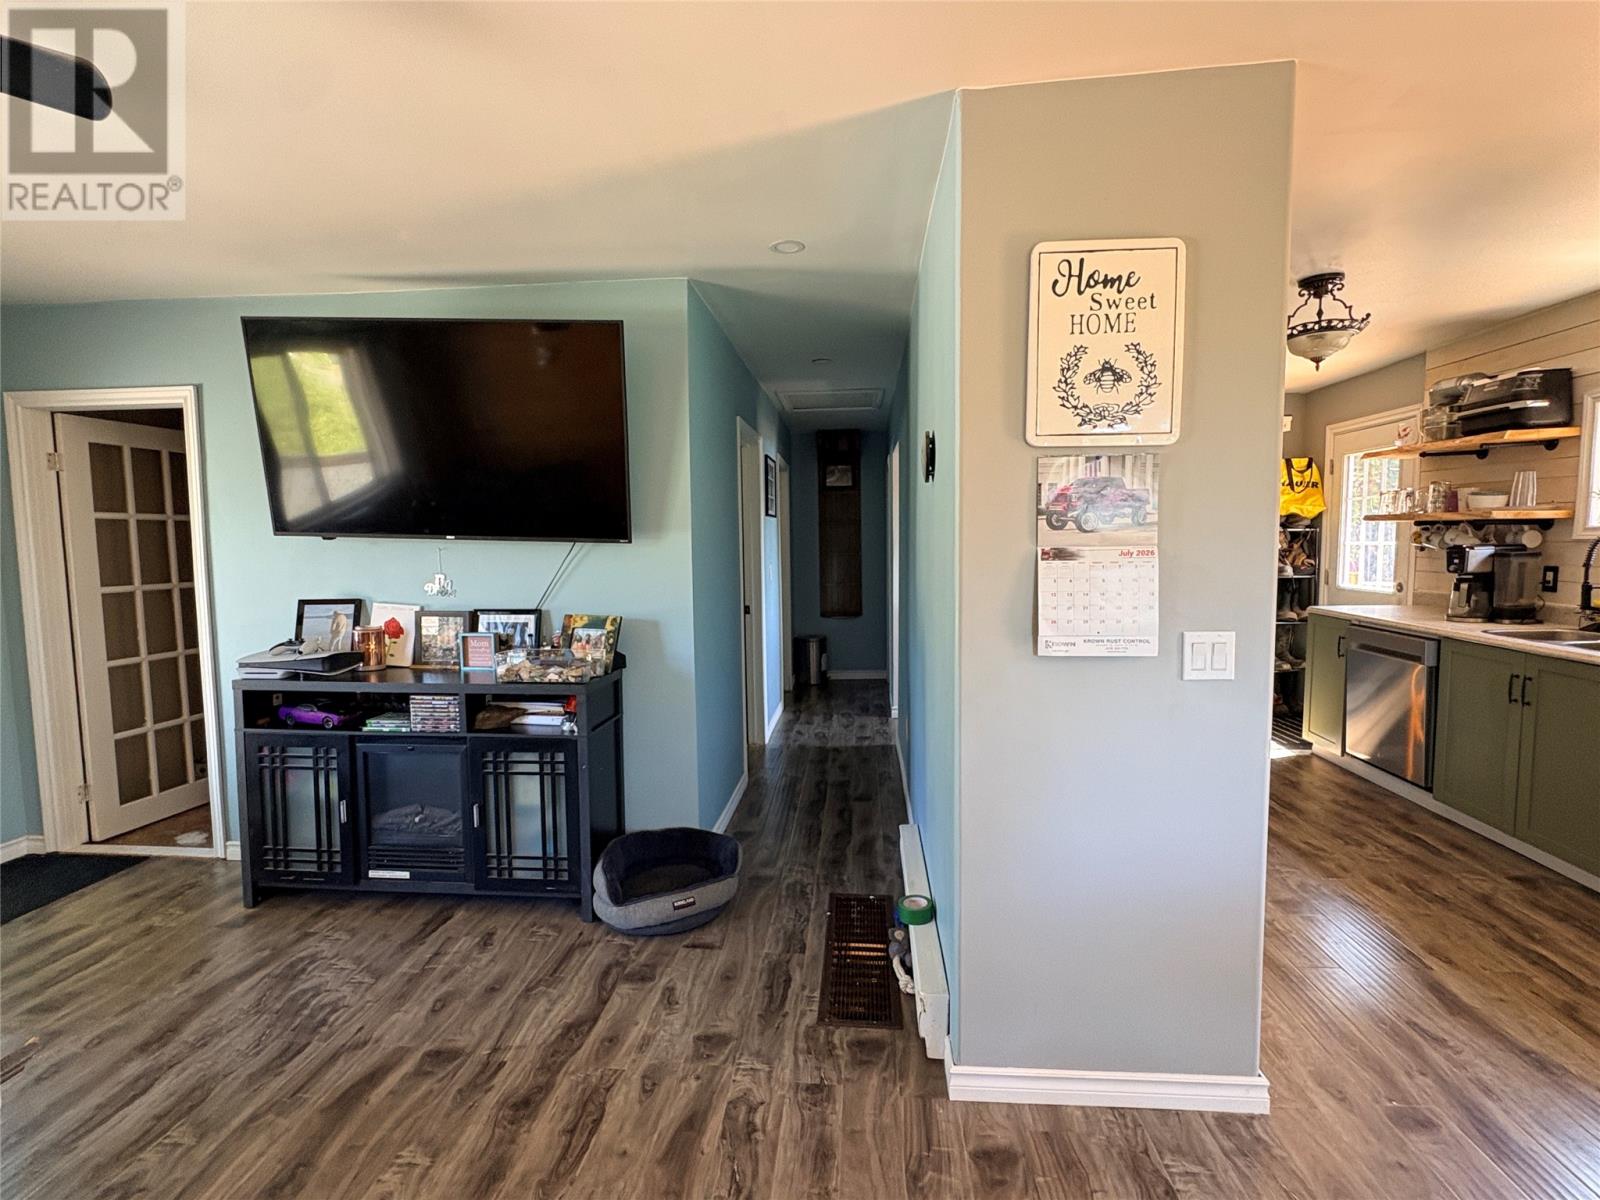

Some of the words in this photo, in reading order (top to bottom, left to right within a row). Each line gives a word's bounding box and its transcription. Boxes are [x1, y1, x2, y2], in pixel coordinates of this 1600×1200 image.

[1051, 257, 1141, 297] Home
[1089, 292, 1157, 311] Sweet
[1069, 312, 1137, 335] HOME
[1118, 549, 1134, 558] July
[1136, 549, 1155, 557] 2026
[470, 639, 489, 647] Mom
